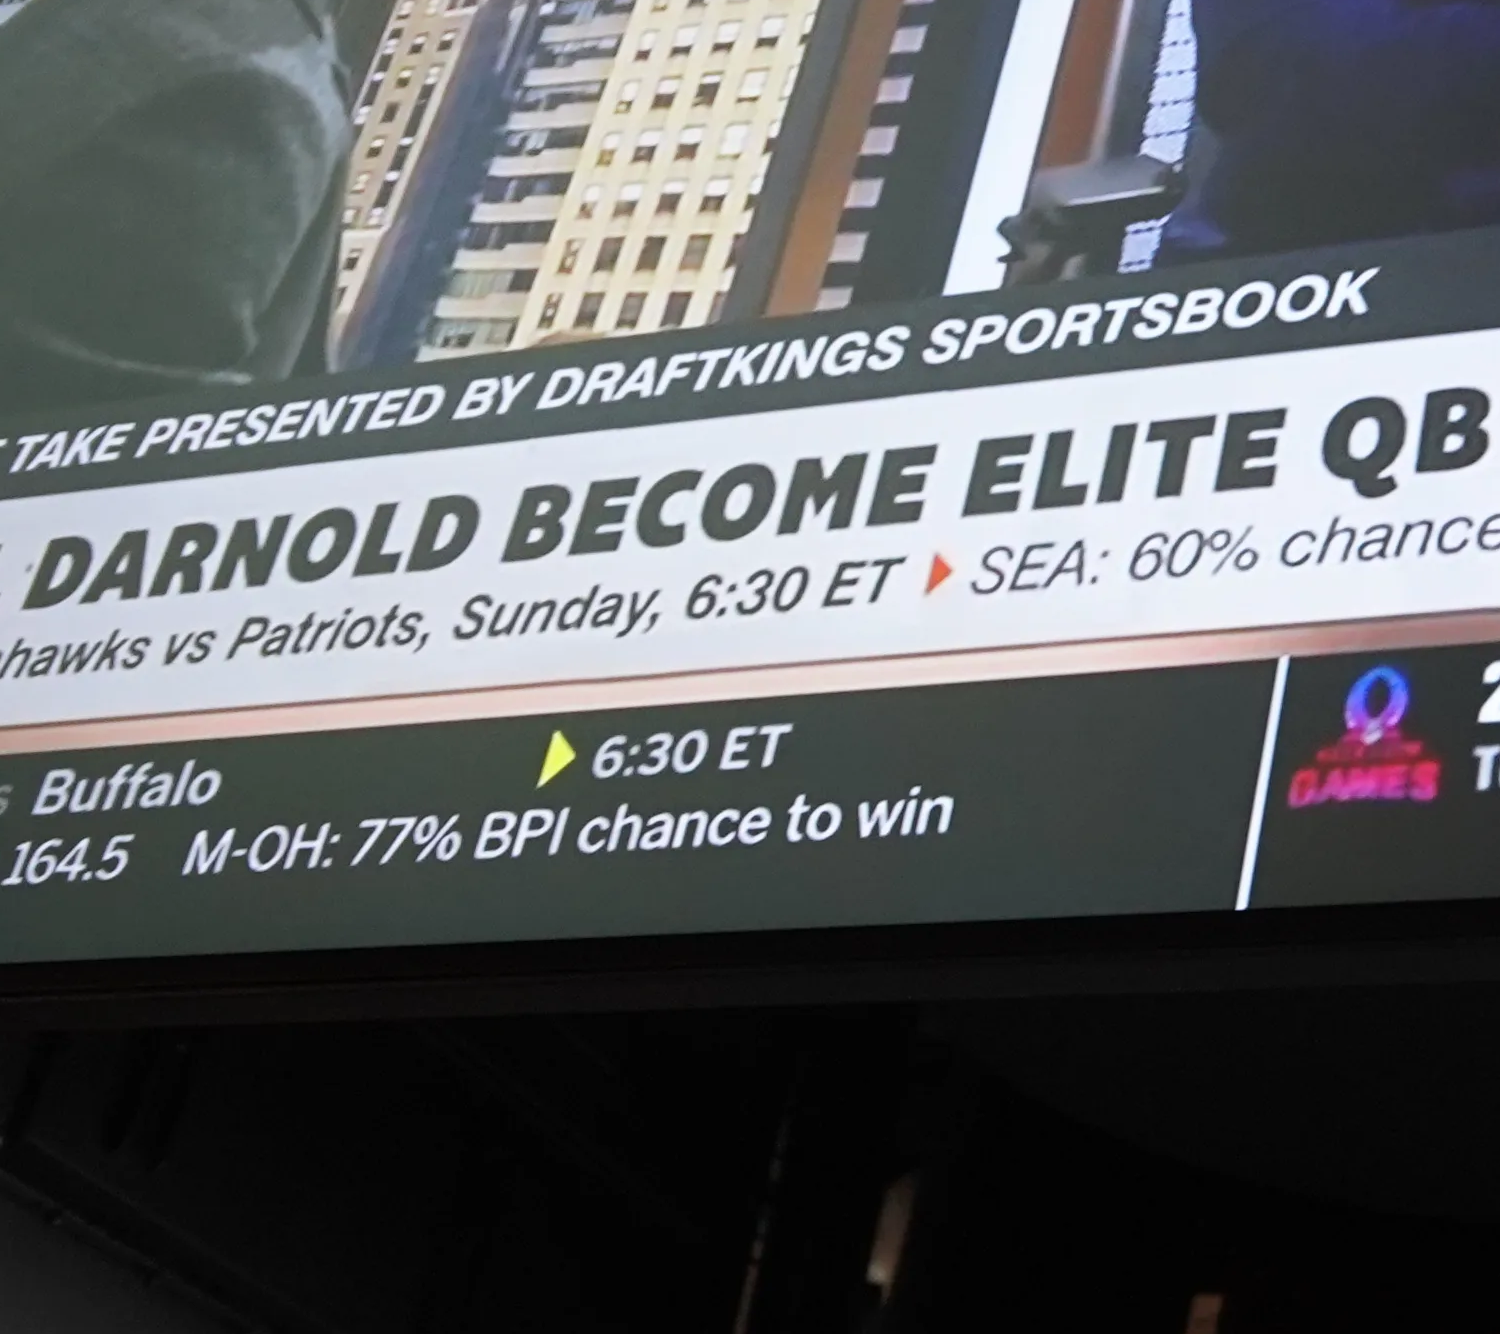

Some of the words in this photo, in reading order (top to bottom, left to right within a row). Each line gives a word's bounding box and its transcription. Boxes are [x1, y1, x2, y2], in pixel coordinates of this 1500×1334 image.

[10, 423, 136, 472] TAKE
[135, 385, 445, 457] PRESENTED
[453, 372, 534, 419] BY
[536, 326, 910, 409] DRAFTKINGS
[923, 268, 1379, 364] SPORTSBOOK
[21, 495, 480, 610] DARNOLD
[501, 444, 938, 563] BECOME
[961, 408, 1287, 517] ELITE
[1322, 387, 1490, 499] QB
[164, 631, 216, 665] vs
[226, 605, 429, 660] Patriots,
[453, 585, 660, 640] Sunday,
[686, 566, 809, 619] 6:30
[822, 557, 907, 607] ET
[971, 540, 1108, 594] SEA:
[1129, 527, 1259, 581] 60%
[32, 760, 221, 814] Buffalo
[593, 730, 708, 778] 6:30
[719, 724, 792, 769] ET
[1, 834, 134, 885] 164.5
[183, 823, 340, 874] M-OH:
[351, 815, 461, 865] 77%
[474, 807, 570, 859] BPI
[578, 804, 771, 853] chance
[787, 795, 841, 842] to
[859, 786, 953, 837] win
